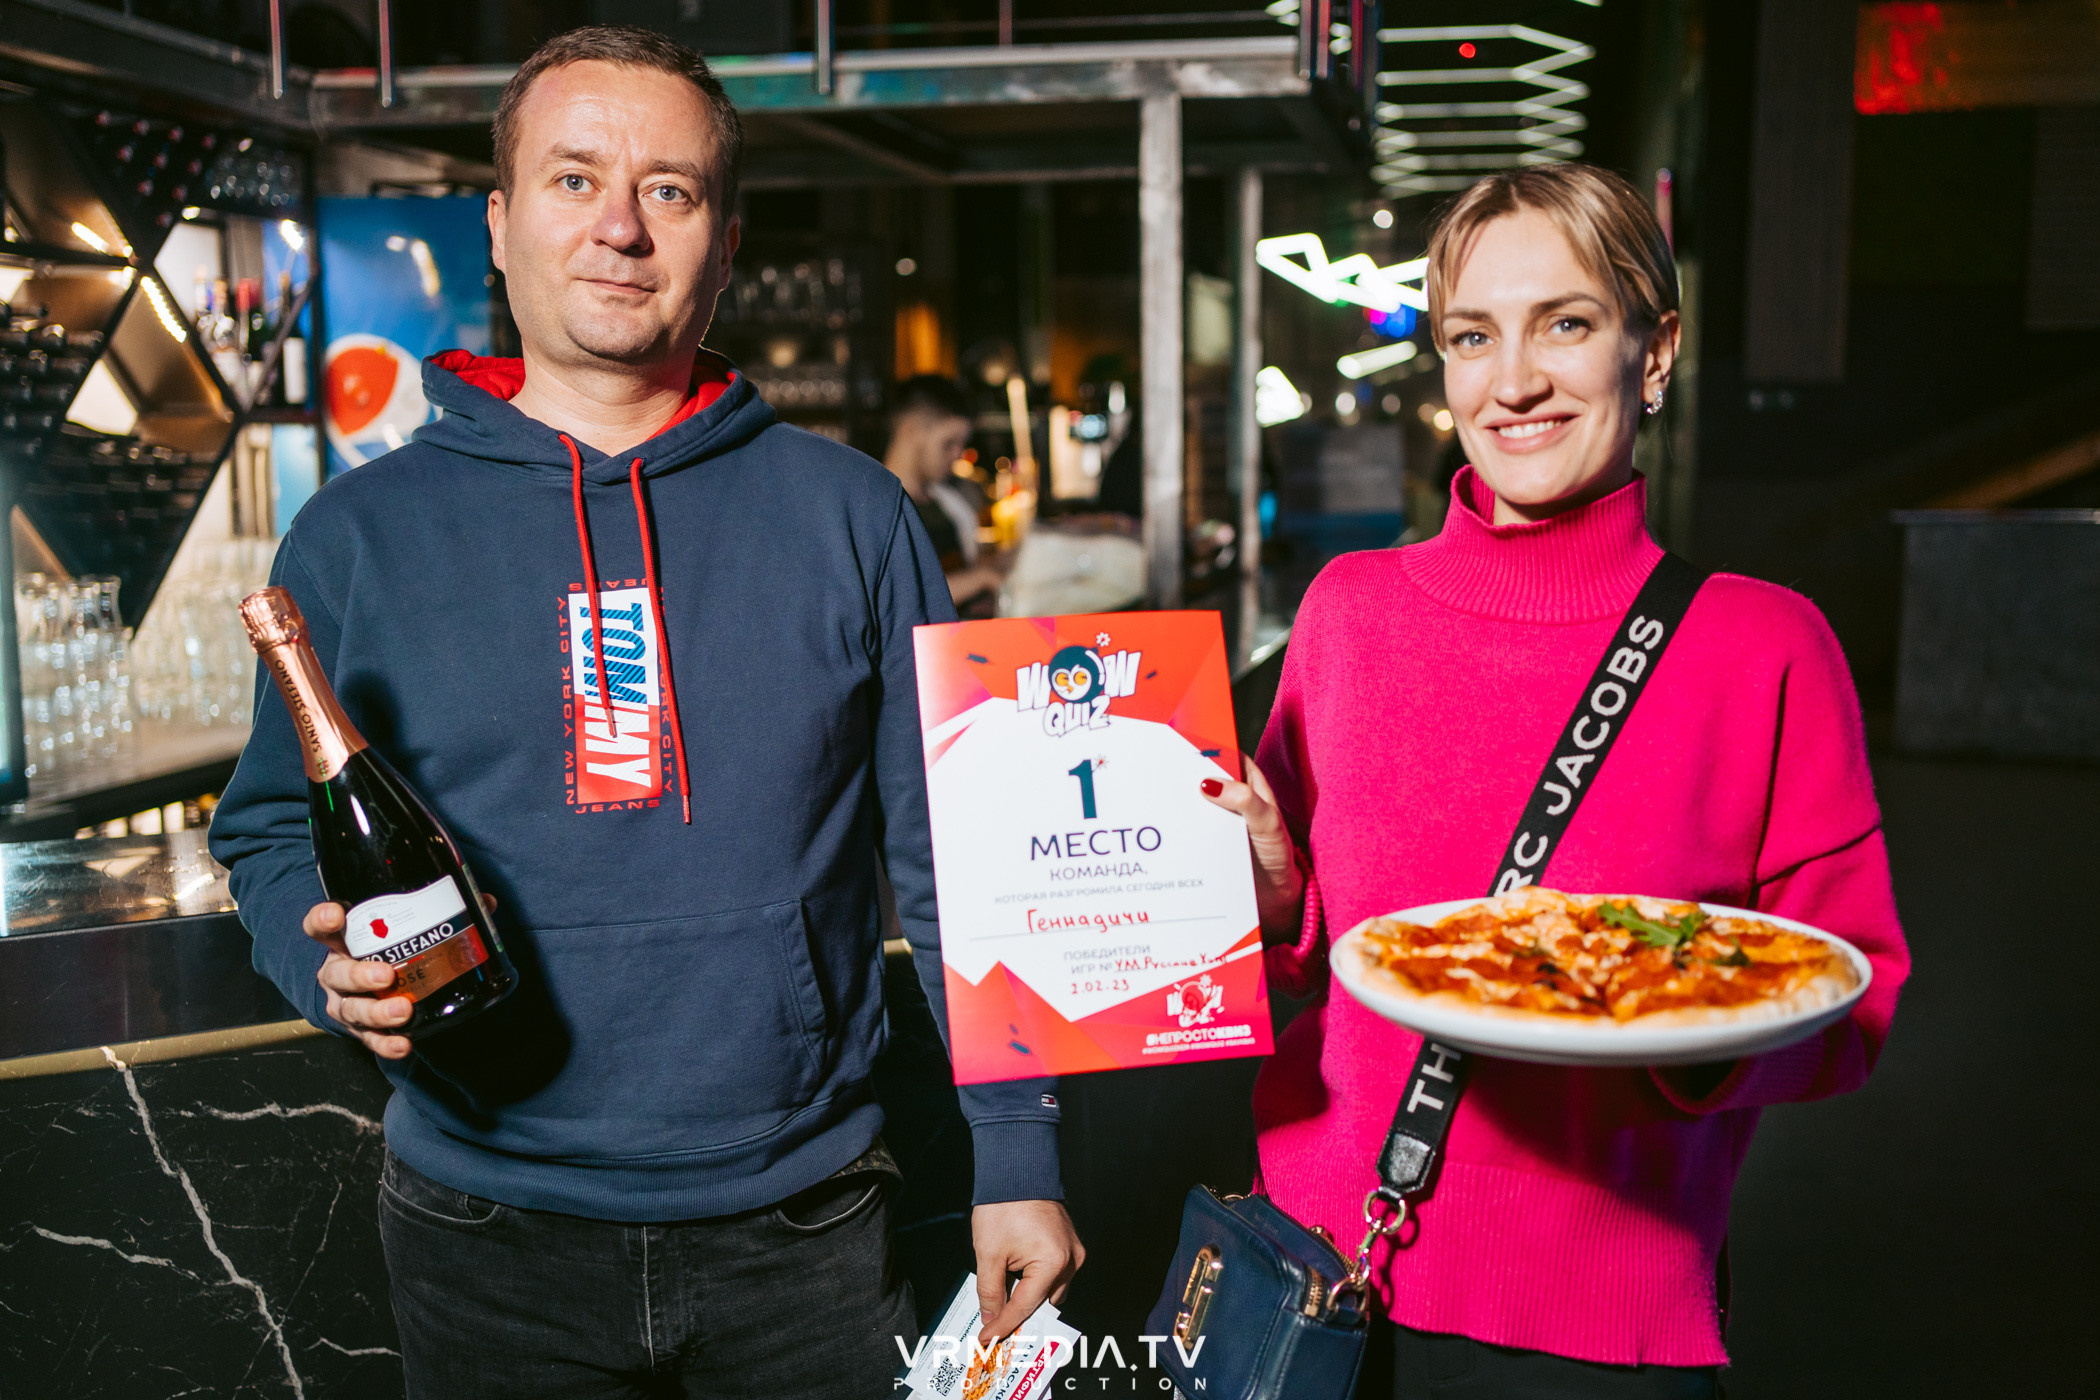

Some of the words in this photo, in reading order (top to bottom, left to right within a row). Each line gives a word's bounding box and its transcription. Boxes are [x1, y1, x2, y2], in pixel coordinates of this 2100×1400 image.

[557, 596, 570, 654] CITY
[275, 659, 307, 711] STEFANO
[561, 665, 574, 738] YORK
[579, 602, 652, 788] TOMMY
[301, 713, 323, 753] SANTO
[1043, 694, 1111, 738] QUIZ
[565, 750, 576, 805] NEW
[662, 734, 673, 793] CITY
[575, 800, 660, 815] JEANS
[1068, 758, 1097, 819] 1
[1031, 826, 1161, 861] МЕСТО
[1406, 1042, 1461, 1113] TH
[1543, 615, 1664, 816] JACOBS
[995, 891, 1047, 904] КОТОРАЯ
[1050, 885, 1122, 899] РАЗГРОМИЛА
[1126, 880, 1174, 893] СЕГОДНЯ
[1178, 878, 1204, 889] ВСЕХ
[1050, 862, 1148, 881] КОМАНДА,
[1027, 909, 1149, 933] Геннадичи
[385, 922, 454, 964] STEFANO
[1064, 944, 1151, 961] ПОБЕДИТЕЛИ
[1071, 963, 1096, 975] ИГР
